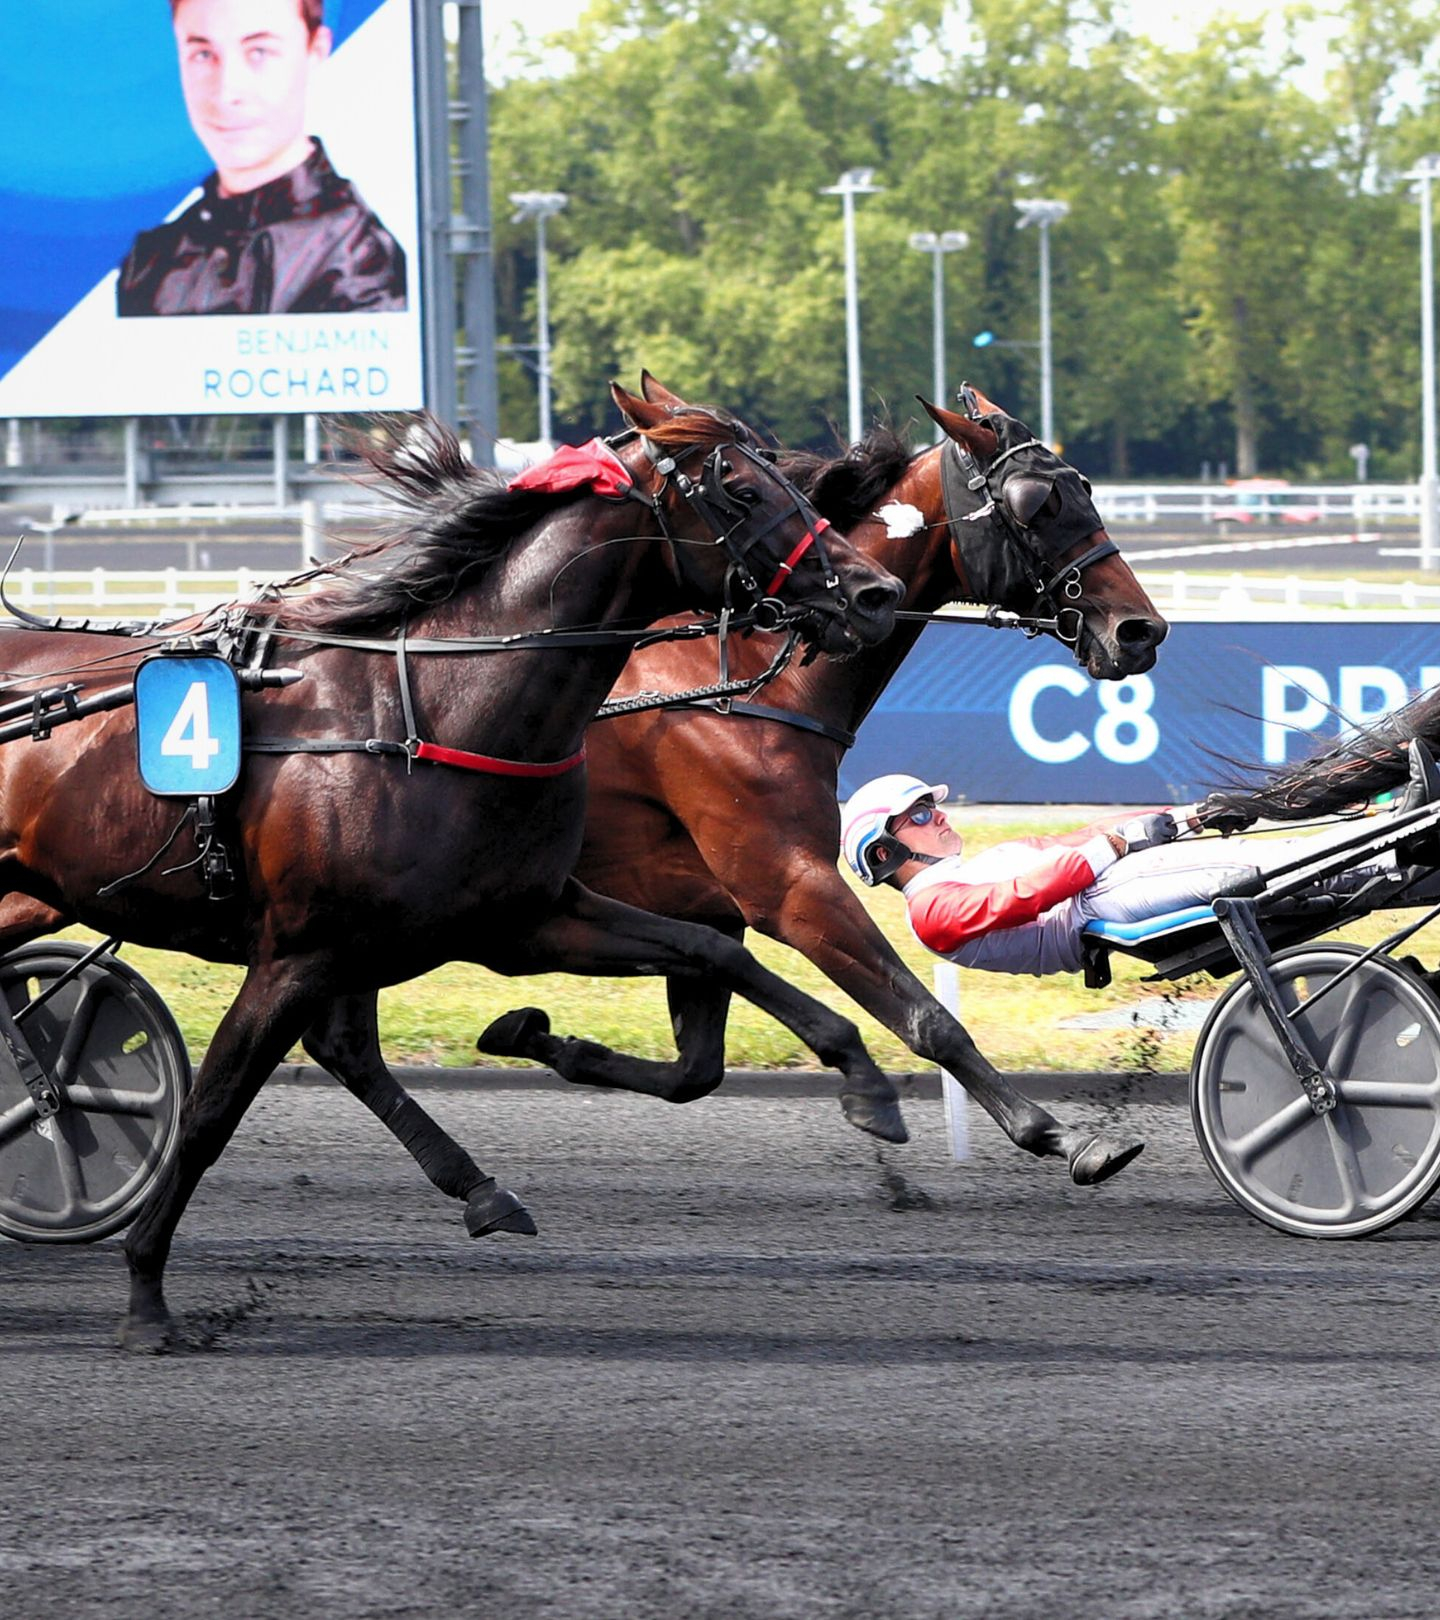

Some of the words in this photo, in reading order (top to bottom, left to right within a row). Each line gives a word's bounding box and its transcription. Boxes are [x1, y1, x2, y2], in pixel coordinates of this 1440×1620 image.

[236, 328, 389, 355] BENJAMIN
[203, 366, 390, 399] ROCHARD
[161, 681, 220, 769] 4
[1008, 663, 1160, 764] C8
